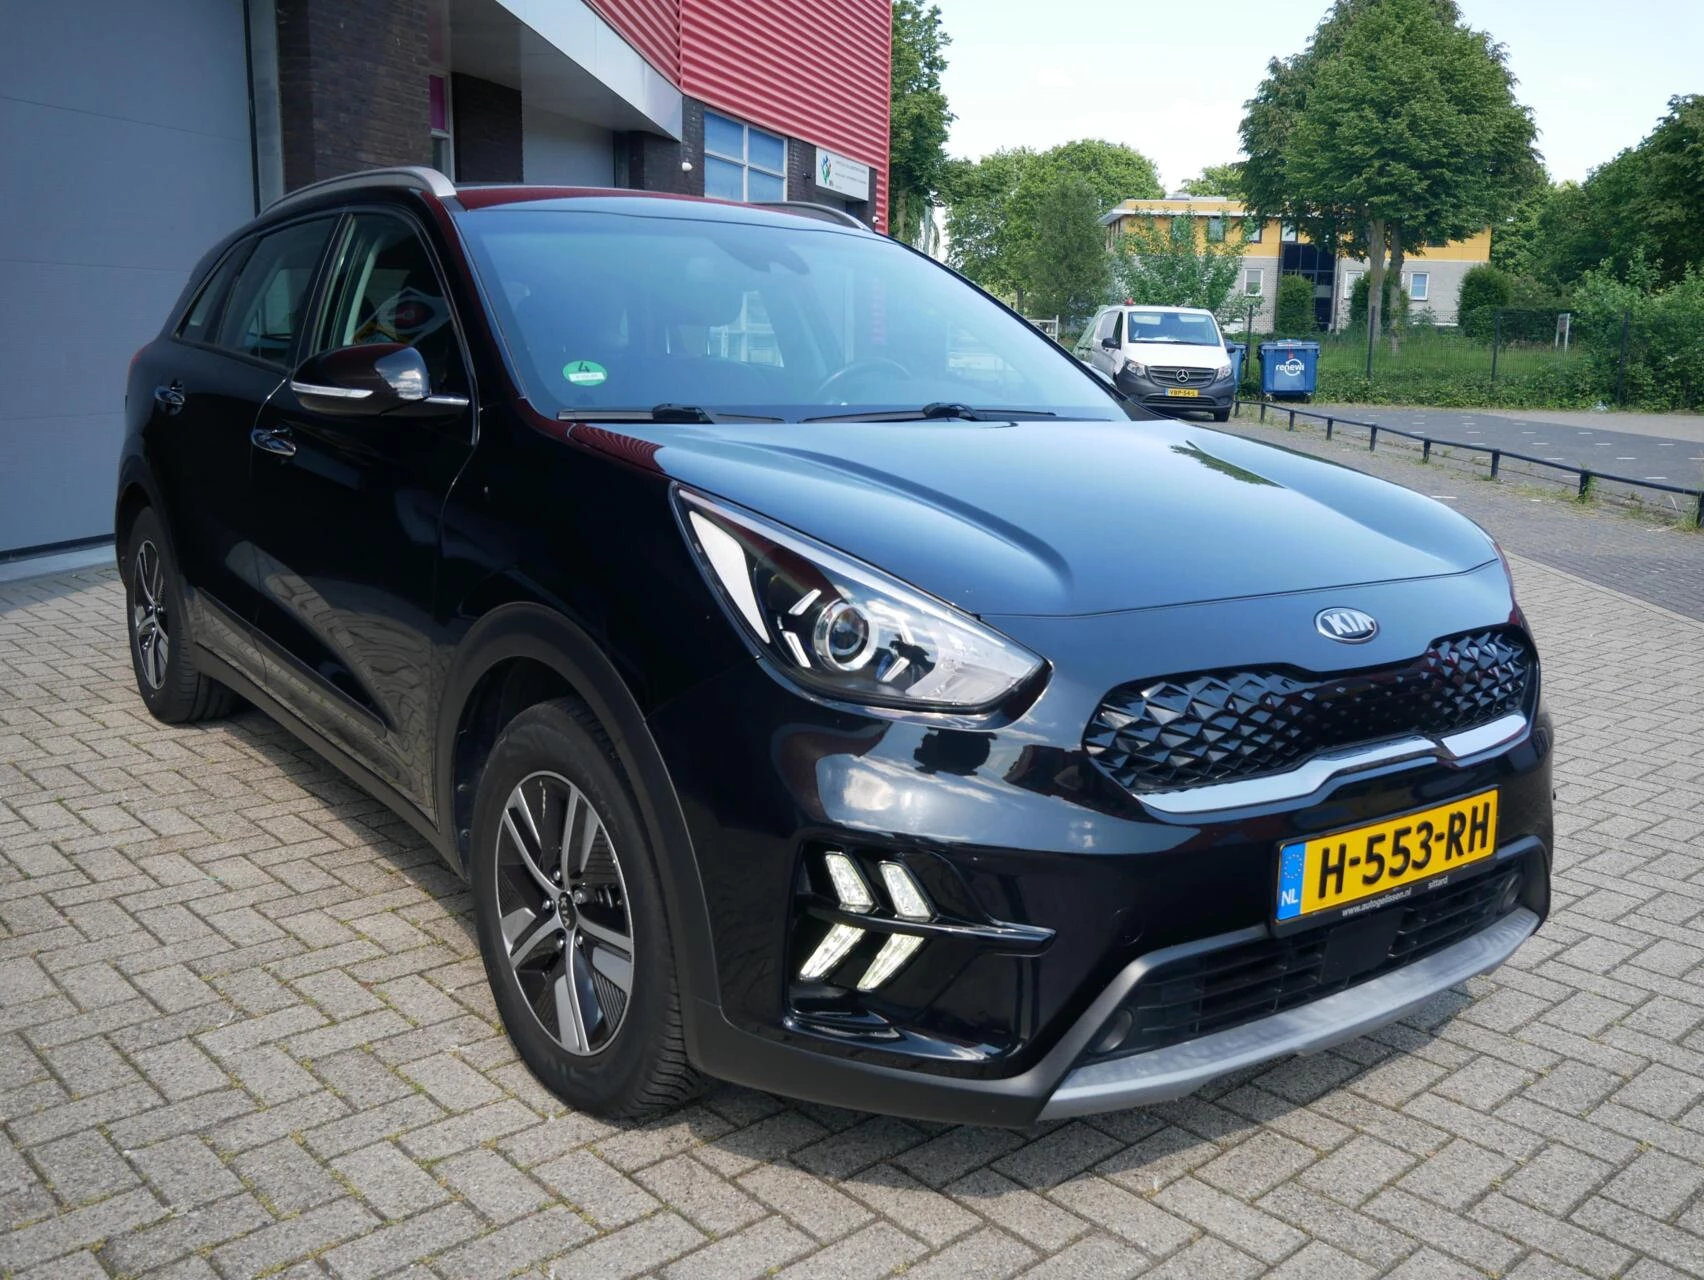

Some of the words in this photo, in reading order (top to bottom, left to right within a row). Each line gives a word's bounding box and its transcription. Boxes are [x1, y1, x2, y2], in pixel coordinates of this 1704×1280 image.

[1275, 361, 1305, 372] renewi
[1323, 612, 1374, 635] KIA
[1317, 801, 1490, 899] H-553-RH
[1281, 888, 1299, 906] NL
